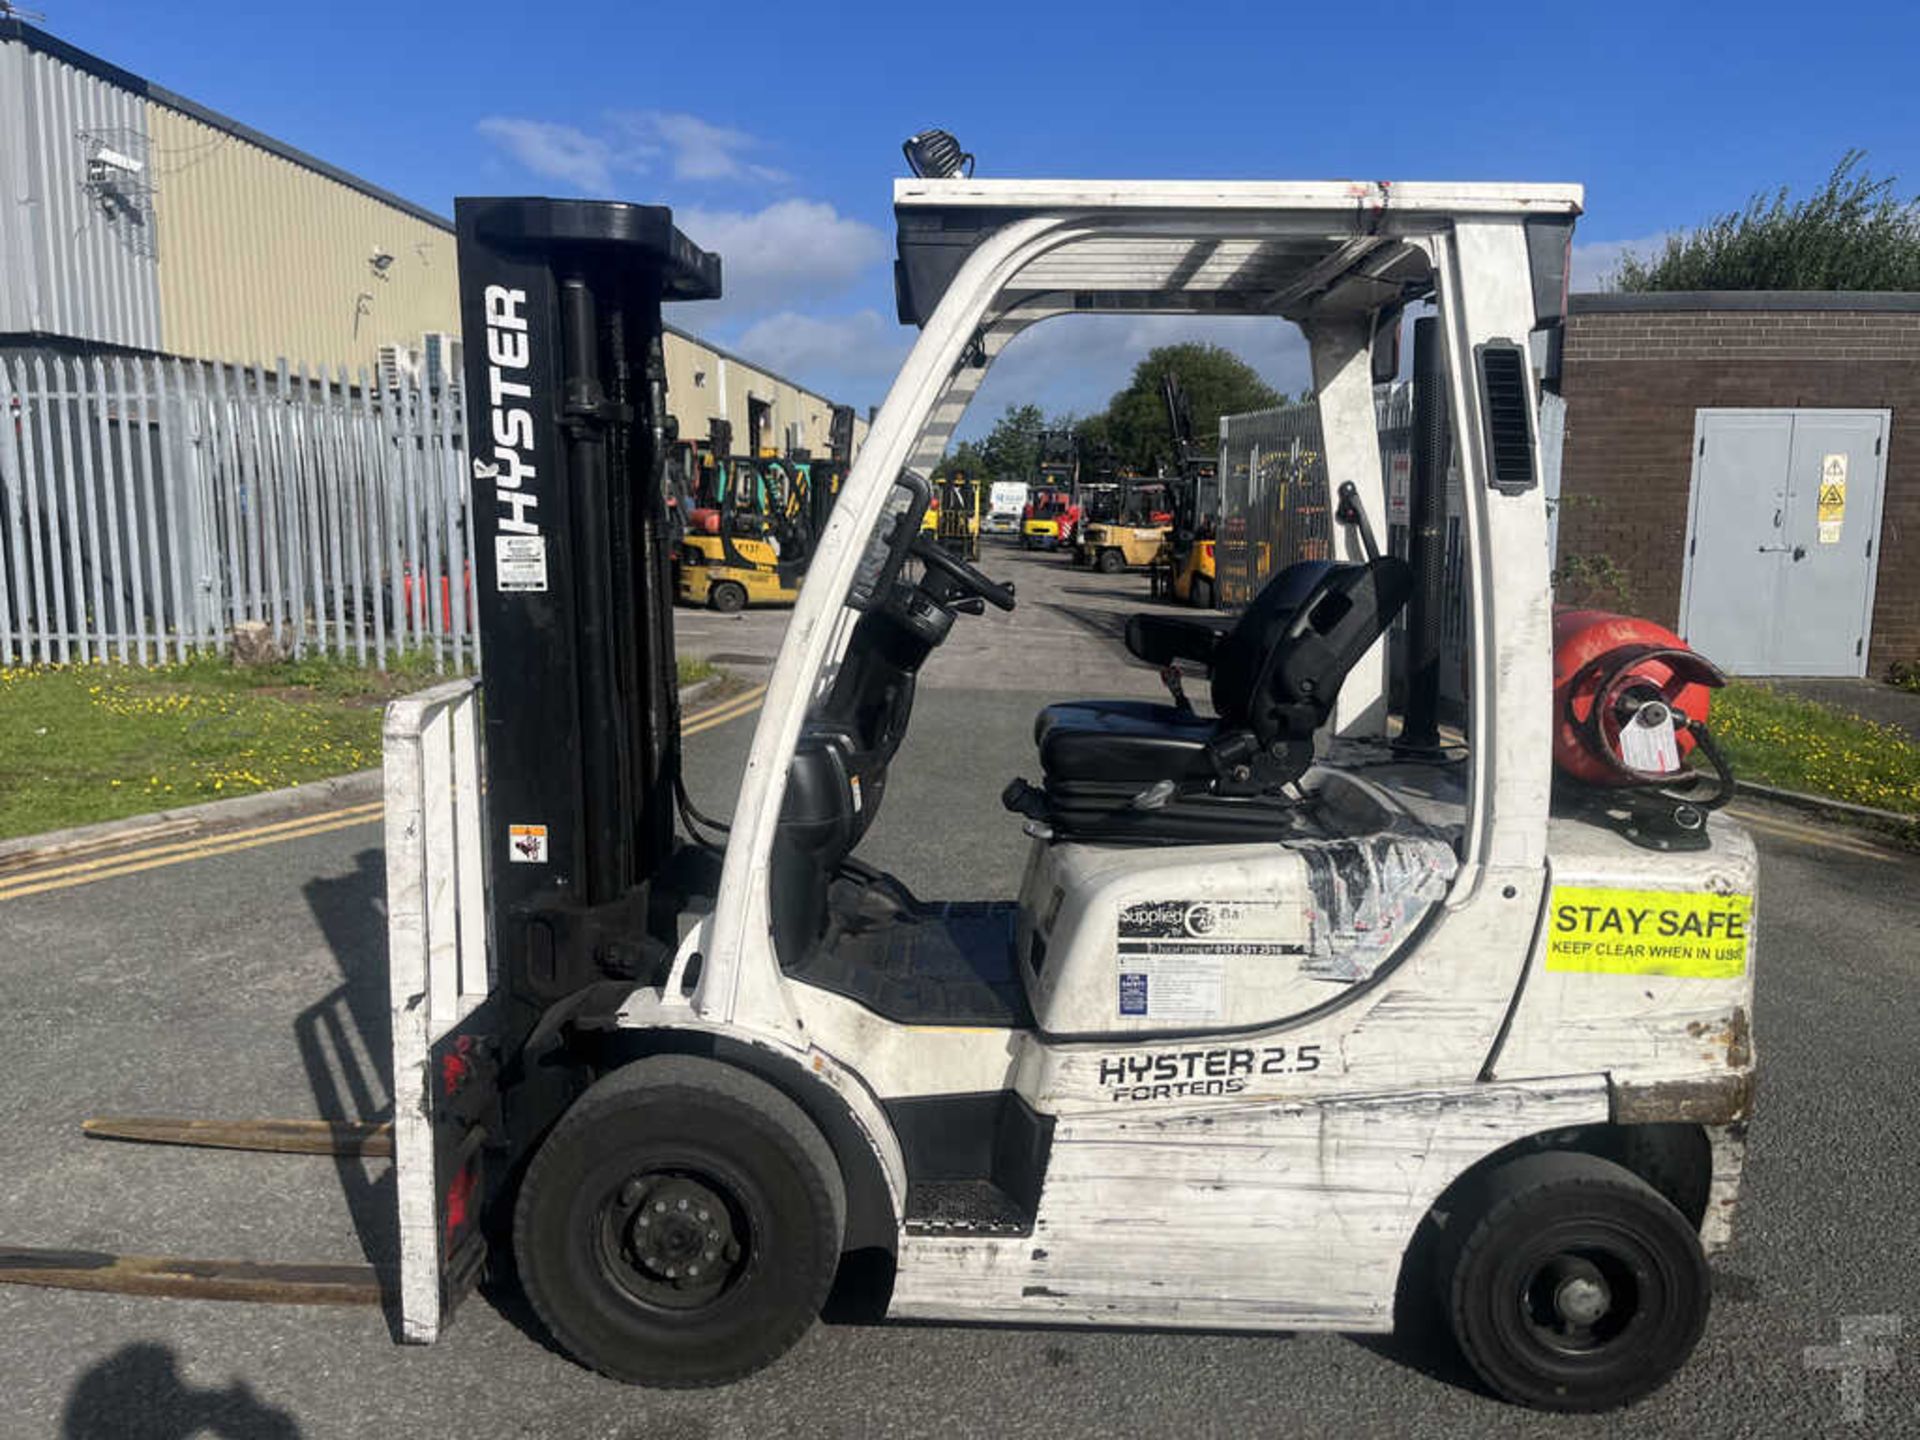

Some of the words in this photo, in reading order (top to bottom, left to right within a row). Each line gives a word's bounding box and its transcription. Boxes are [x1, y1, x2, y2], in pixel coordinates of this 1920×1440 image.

[485, 284, 539, 535] HYSTER
[1556, 905, 1648, 934] STAY
[1657, 910, 1744, 938] SAFE
[1552, 940, 1592, 955] KEEP
[1595, 942, 1645, 957] CLEAR
[1649, 945, 1692, 959] WHEN
[1696, 947, 1710, 959] IN
[1100, 1049, 1255, 1085] HYSTER
[1261, 1045, 1321, 1074] 2.5
[1113, 1077, 1246, 1101] FORTENS
